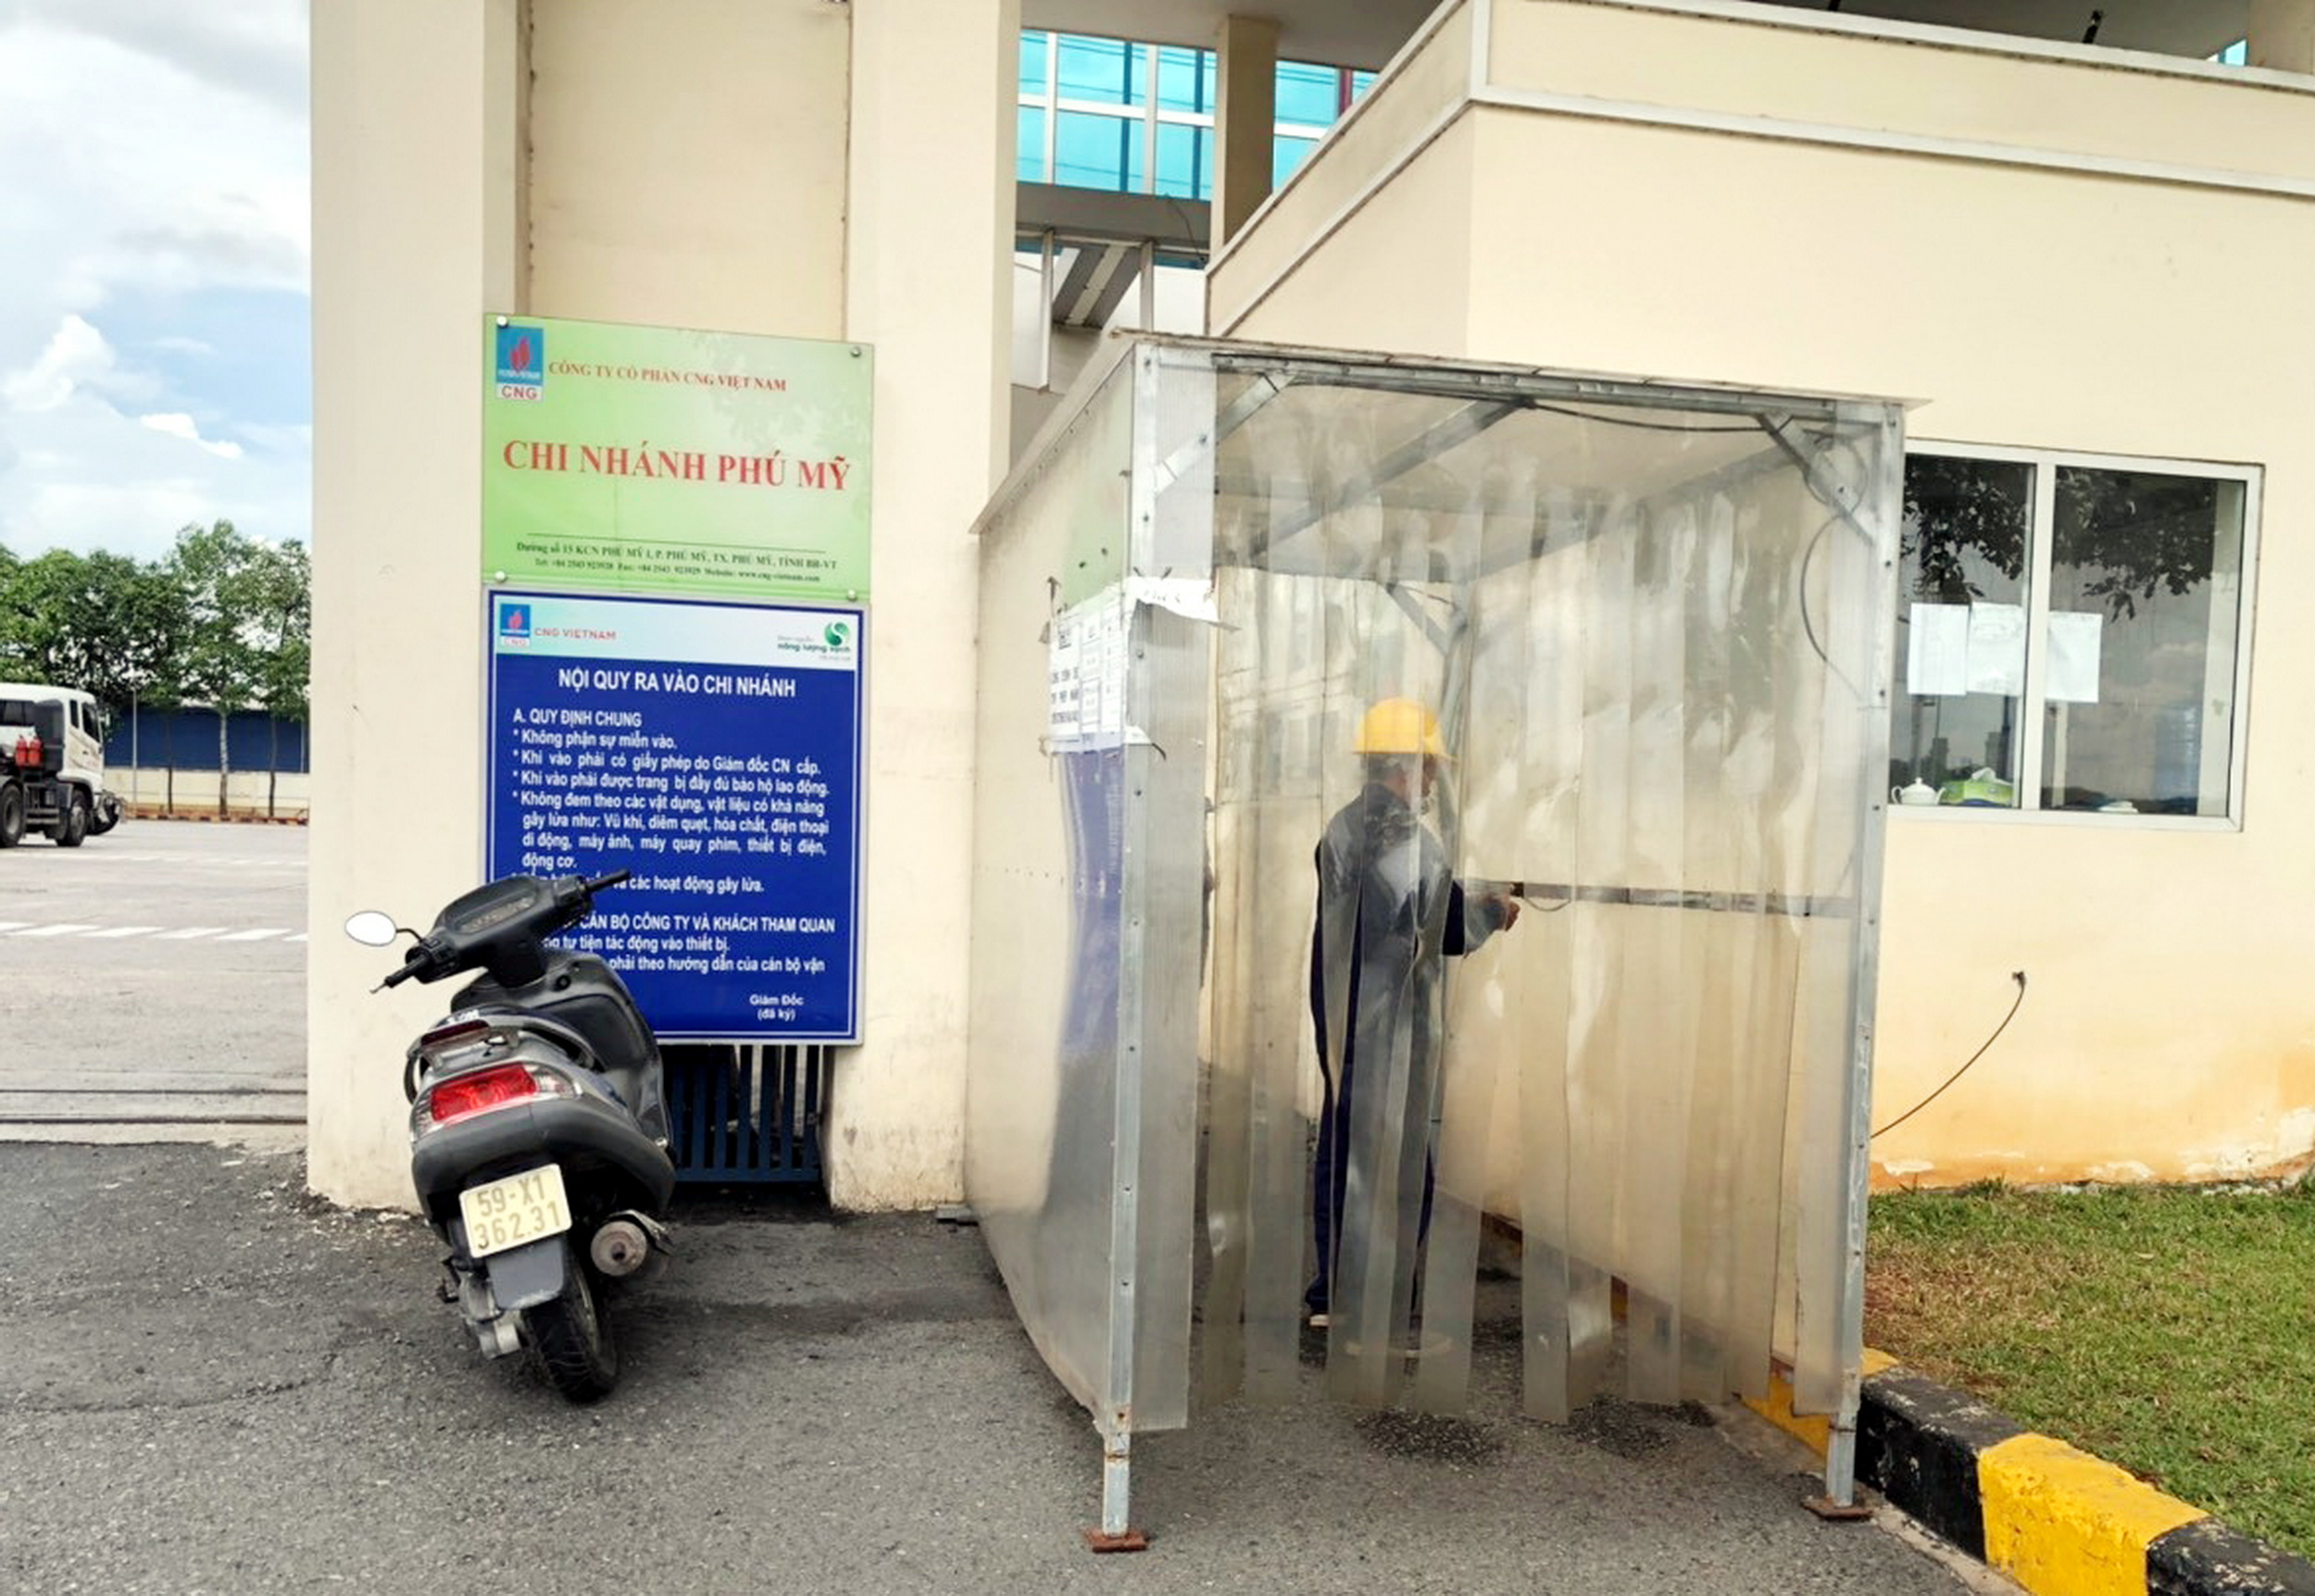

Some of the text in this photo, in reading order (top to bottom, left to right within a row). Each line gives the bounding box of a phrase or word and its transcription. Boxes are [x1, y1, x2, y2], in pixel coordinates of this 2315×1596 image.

[548, 359, 592, 377] CÔNG
[595, 366, 612, 378] TY
[683, 372, 714, 386] CNG
[718, 374, 751, 391] VIỆT
[754, 378, 786, 392] NAM
[501, 385, 537, 400] CNG
[503, 440, 850, 491] CHI NHÁNH PHÚ MỸ
[550, 541, 560, 553] số
[563, 544, 574, 554] 15
[576, 545, 600, 555] KCN
[602, 544, 622, 556] PHÚ
[627, 546, 644, 557] MỸ
[667, 549, 686, 560] PHÚ
[732, 554, 752, 565] PHÚ
[534, 628, 560, 638] CNG
[562, 629, 617, 640] VIETNAM
[558, 667, 795, 697] NỘI QUY RA VÀO CHI NHÁNH
[513, 707, 643, 728] A. QUY ĐỊNH CHUNG
[521, 729, 677, 750] Không phận sự miễn vào.
[521, 749, 821, 777] Khi vào phải có giấy phép do Giám đốc CN cấp.
[521, 770, 830, 798] Khi vào phải được trang bị đầy đủ bảo hộ lao động.
[521, 791, 825, 817] Không đem theo các vật dụng, vật liệu có khả năng
[522, 811, 830, 837] gây lửa như: Vũ khí, diêm quẹt, hóa chất, điện thoại
[522, 832, 826, 856] di động, máy ảnh, máy quay phim, thiết bị điện,
[522, 853, 577, 871] động cơ.
[630, 874, 651, 890] các
[654, 876, 681, 892] hoạt
[683, 876, 714, 894] động
[717, 877, 739, 894] gây
[742, 877, 765, 892] lửa.
[610, 913, 630, 931] BỘ
[632, 912, 670, 929] CÔNG
[674, 916, 690, 930] TY
[693, 913, 710, 930] VÀ
[713, 913, 758, 931] KHÁCH
[761, 916, 796, 931] THAM
[798, 917, 835, 933] QUAN
[580, 934, 602, 952] tiện
[606, 935, 624, 949] tác
[627, 935, 658, 954] động
[661, 936, 683, 950] vào
[686, 933, 713, 951] thiết
[716, 936, 730, 954] bị.
[638, 956, 665, 971] theo
[668, 956, 709, 974] hướng
[711, 954, 734, 971] dẫn
[736, 956, 758, 971] của
[761, 956, 782, 971] cán
[785, 957, 801, 974] bộ
[803, 957, 826, 974] vận
[749, 992, 804, 1005] Giám Đốc
[757, 1008, 795, 1021] (đã ký)
[477, 1175, 544, 1216] 59-X1
[474, 1201, 560, 1250] 362.31
